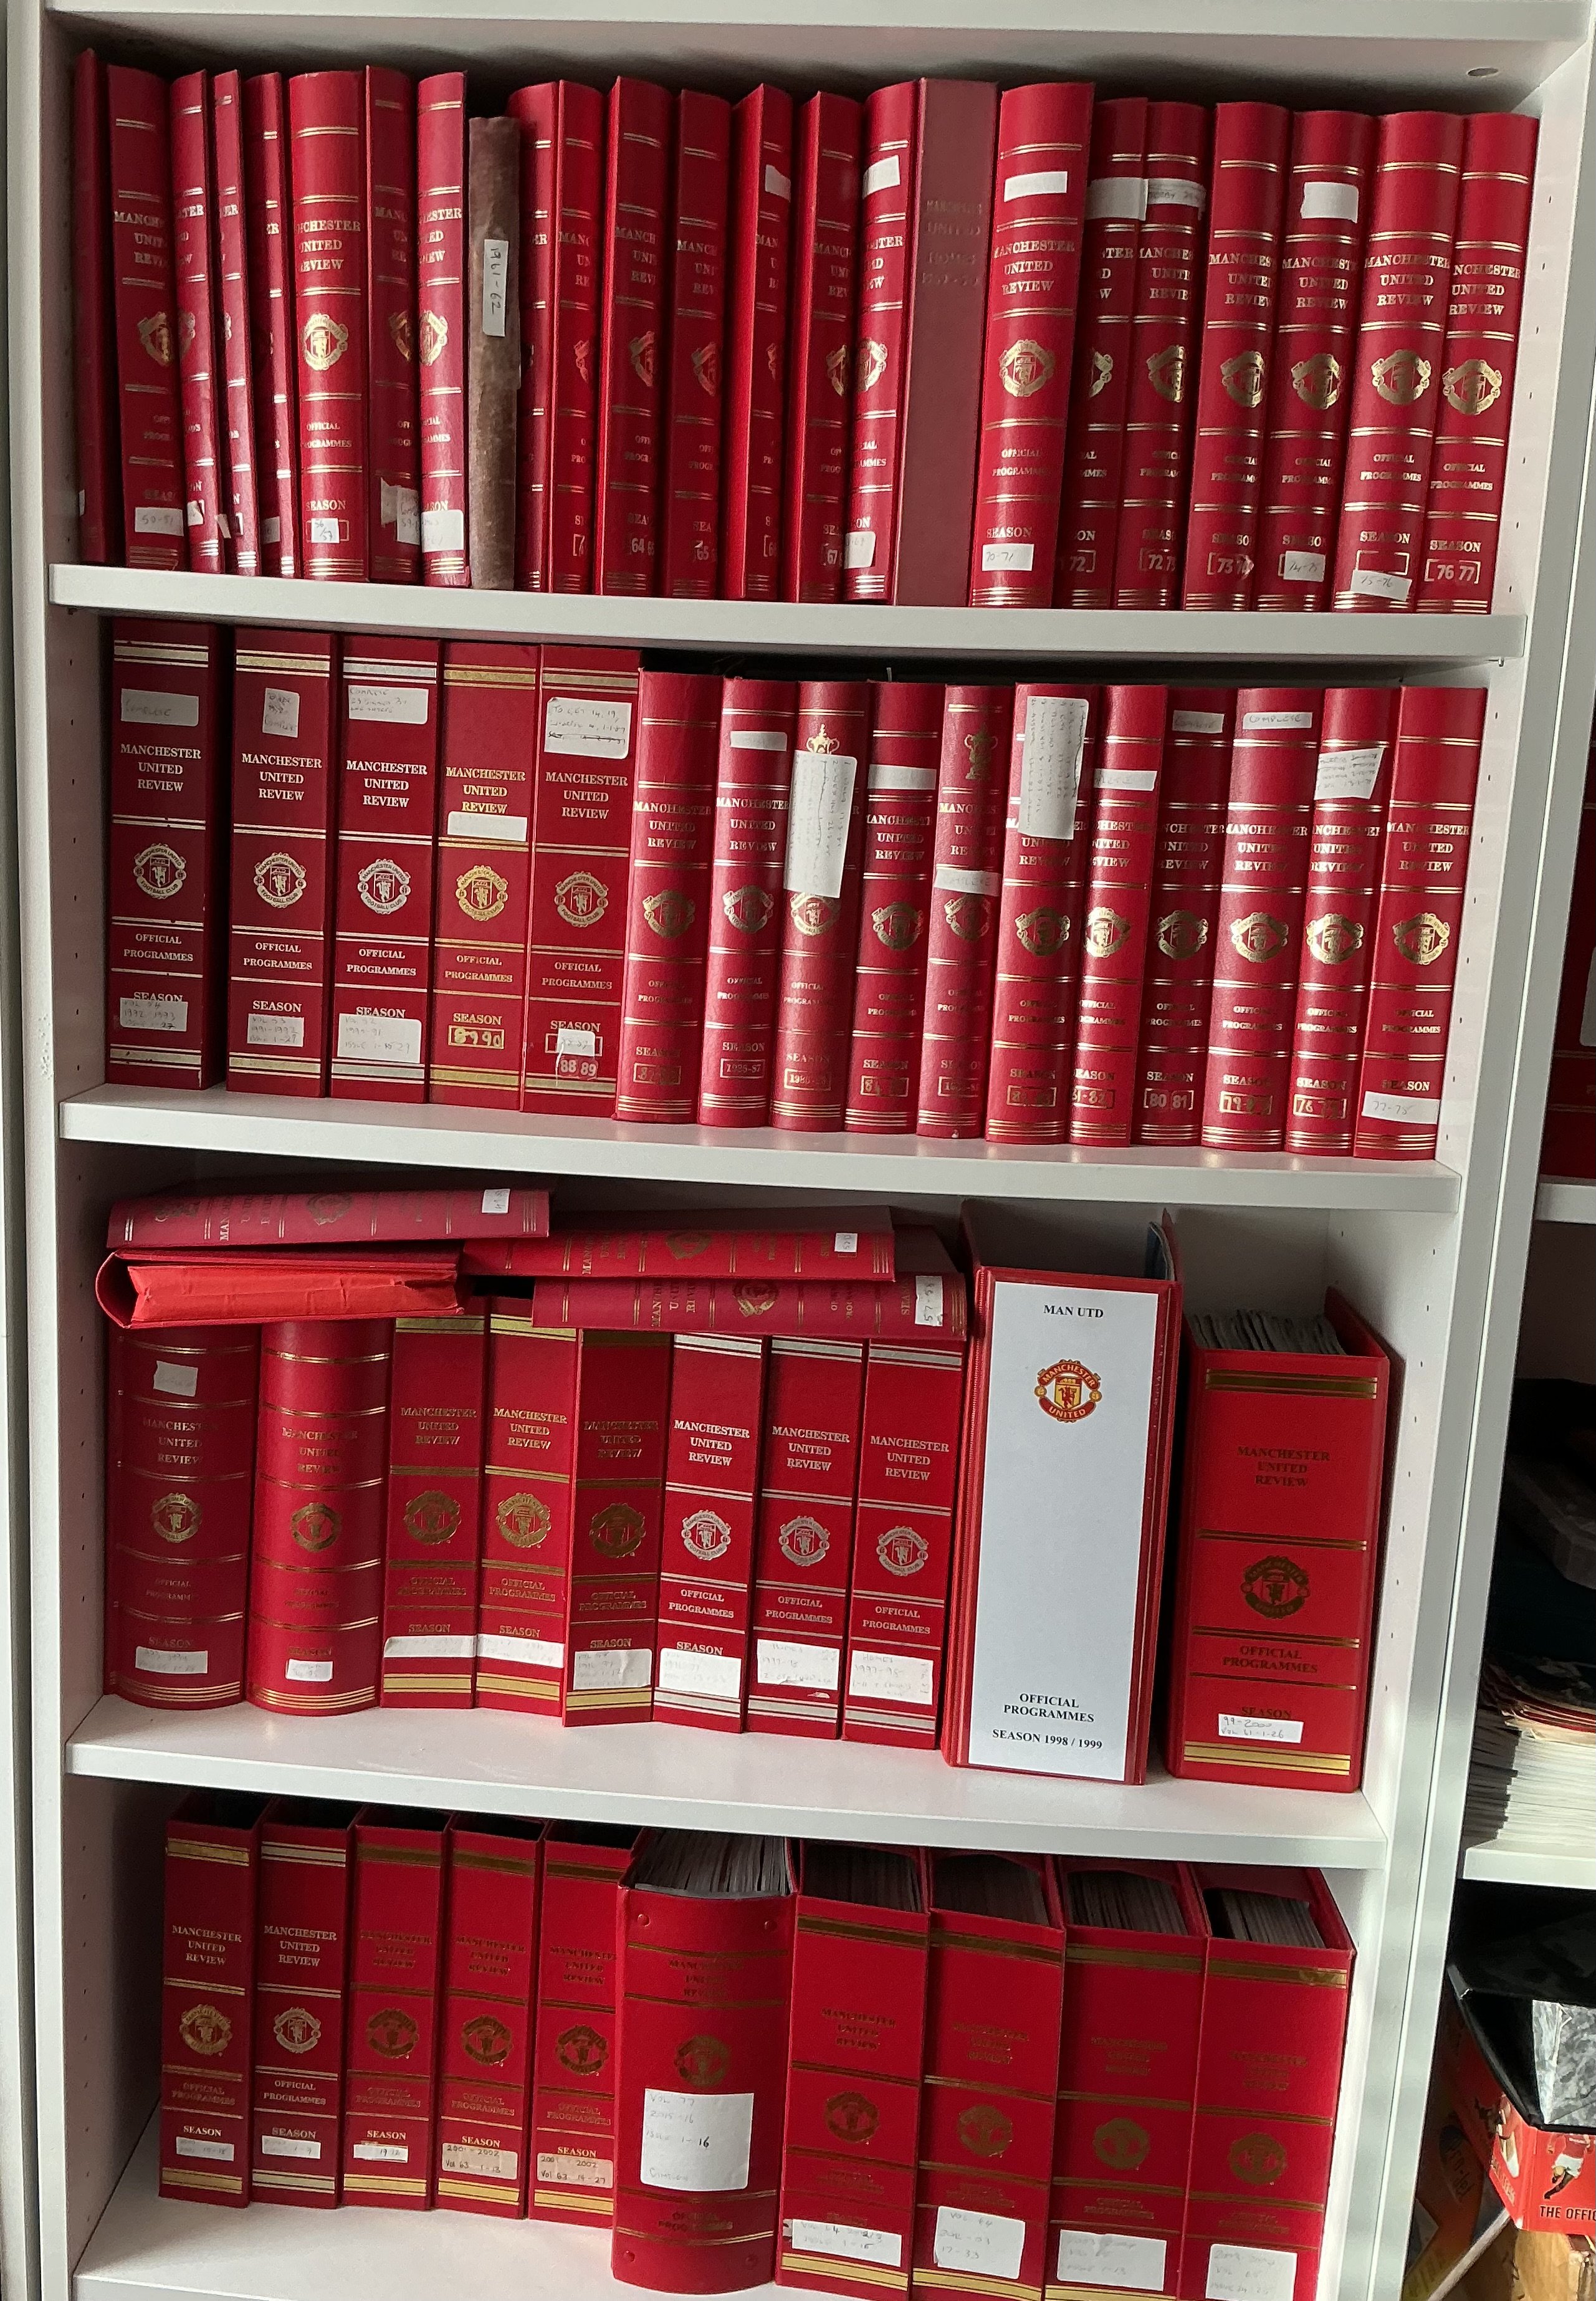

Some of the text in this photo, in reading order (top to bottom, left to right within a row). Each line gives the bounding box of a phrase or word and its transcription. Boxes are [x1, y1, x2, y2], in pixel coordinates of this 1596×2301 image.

[1004, 260, 1053, 275] UNITED
[1002, 280, 1054, 295] REVIEW
[306, 500, 346, 512] SEASON
[986, 526, 1033, 538] SEASON
[1359, 531, 1410, 544] SEASON
[1430, 540, 1481, 552] SEASON
[120, 744, 201, 759] MANCHESTER
[242, 753, 322, 768] MANCHESTER
[138, 762, 183, 775] UNITED
[346, 760, 428, 775] MANCHESTER
[446, 766, 526, 782] MANCHESTER
[259, 771, 304, 784] UNITED
[545, 772, 628, 787] MANCHESTER
[138, 780, 184, 792] REVIEW
[364, 778, 409, 791] UNITED
[463, 785, 507, 797] UNITED
[259, 788, 304, 801] REVIEW
[563, 790, 609, 802] UNITED
[363, 795, 409, 808] REVIEW
[462, 801, 507, 814] REVIEW
[561, 807, 609, 820] REVIEW
[136, 934, 182, 944] OFFICIAL
[256, 942, 302, 953] OFFICIAL
[124, 949, 193, 962] PROGRAMMES
[358, 949, 405, 960] OFFICIAL
[456, 955, 502, 967] OFFICIAL
[243, 958, 313, 970] PROGRAMMES
[346, 964, 416, 976] PROGRAMMES
[554, 962, 601, 973] OFFICIAL
[445, 970, 513, 983] PROGRAMMES
[541, 977, 612, 990] PROGRAMMES
[133, 992, 183, 1002] SEASON
[253, 1000, 302, 1013] SEASON
[356, 1006, 406, 1019] SEASON
[453, 1012, 502, 1025] SEASON
[550, 1020, 601, 1033] SEASON
[560, 1059, 596, 1076] 88 89
[1043, 1304, 1104, 1318] MAN UTD
[1043, 1364, 1095, 1387] MANCHESTER
[494, 1407, 568, 1425] MANCHESTER
[1049, 1405, 1086, 1418] UNITED
[509, 1423, 550, 1435] UNITED
[674, 1420, 750, 1438] MANCHESTER
[772, 1426, 850, 1443] MANCHESTER
[507, 1437, 551, 1450] REVIEW
[689, 1437, 732, 1451] UNITED
[788, 1443, 831, 1456] UNITED
[871, 1435, 949, 1453] MANCHESTER
[689, 1452, 732, 1466] REVIEW
[887, 1452, 930, 1466] UNITED
[1238, 1446, 1331, 1461] MANCHESTER
[786, 1457, 831, 1471] REVIEW
[1258, 1461, 1307, 1474] UNITED
[885, 1467, 930, 1481] REVIEW
[1255, 1475, 1308, 1486] REVIEW
[681, 1589, 725, 1602] OFFICIAL
[777, 1596, 823, 1609] OFFICIAL
[668, 1602, 734, 1619] PROGRAMMES
[765, 1610, 833, 1624] PROGRAMMES
[875, 1605, 920, 1619] OFFICIAL
[408, 1624, 451, 1634] SEASON
[499, 1625, 540, 1638] SEASON
[862, 1620, 931, 1635] PROGRAMMES
[590, 1638, 632, 1648] SEASON
[676, 1641, 723, 1655] SEASON
[1240, 1645, 1302, 1660] OFFICIAL
[1223, 1657, 1318, 1673] PROGRAMMES
[1020, 1693, 1079, 1708] OFFICIAL
[1004, 1705, 1094, 1723] PROGRAMMES
[1241, 1706, 1292, 1719] SEASON
[992, 1729, 1041, 1743] SEASON
[1045, 1735, 1068, 1746] 1998
[1079, 1739, 1102, 1749] 1999
[172, 1925, 242, 1943] MANCHESTER
[264, 1926, 337, 1941] MANCHESTER
[188, 1940, 226, 1953] UNITED
[279, 1940, 320, 1953] UNITED
[186, 1953, 227, 1966] REVIEW
[278, 1954, 320, 1967] REVIEW
[274, 2080, 316, 2091] OFFICIAL
[264, 2092, 327, 2106] PROGRAMMES
[183, 2125, 222, 2136] SEASON
[272, 2127, 317, 2140] SEASON
[366, 2130, 406, 2140] SEASON
[461, 2136, 500, 2148] SEASON
[557, 2146, 596, 2158] SEASON
[541, 2171, 552, 2179] Vol
[1540, 2206, 1561, 2218] THE
